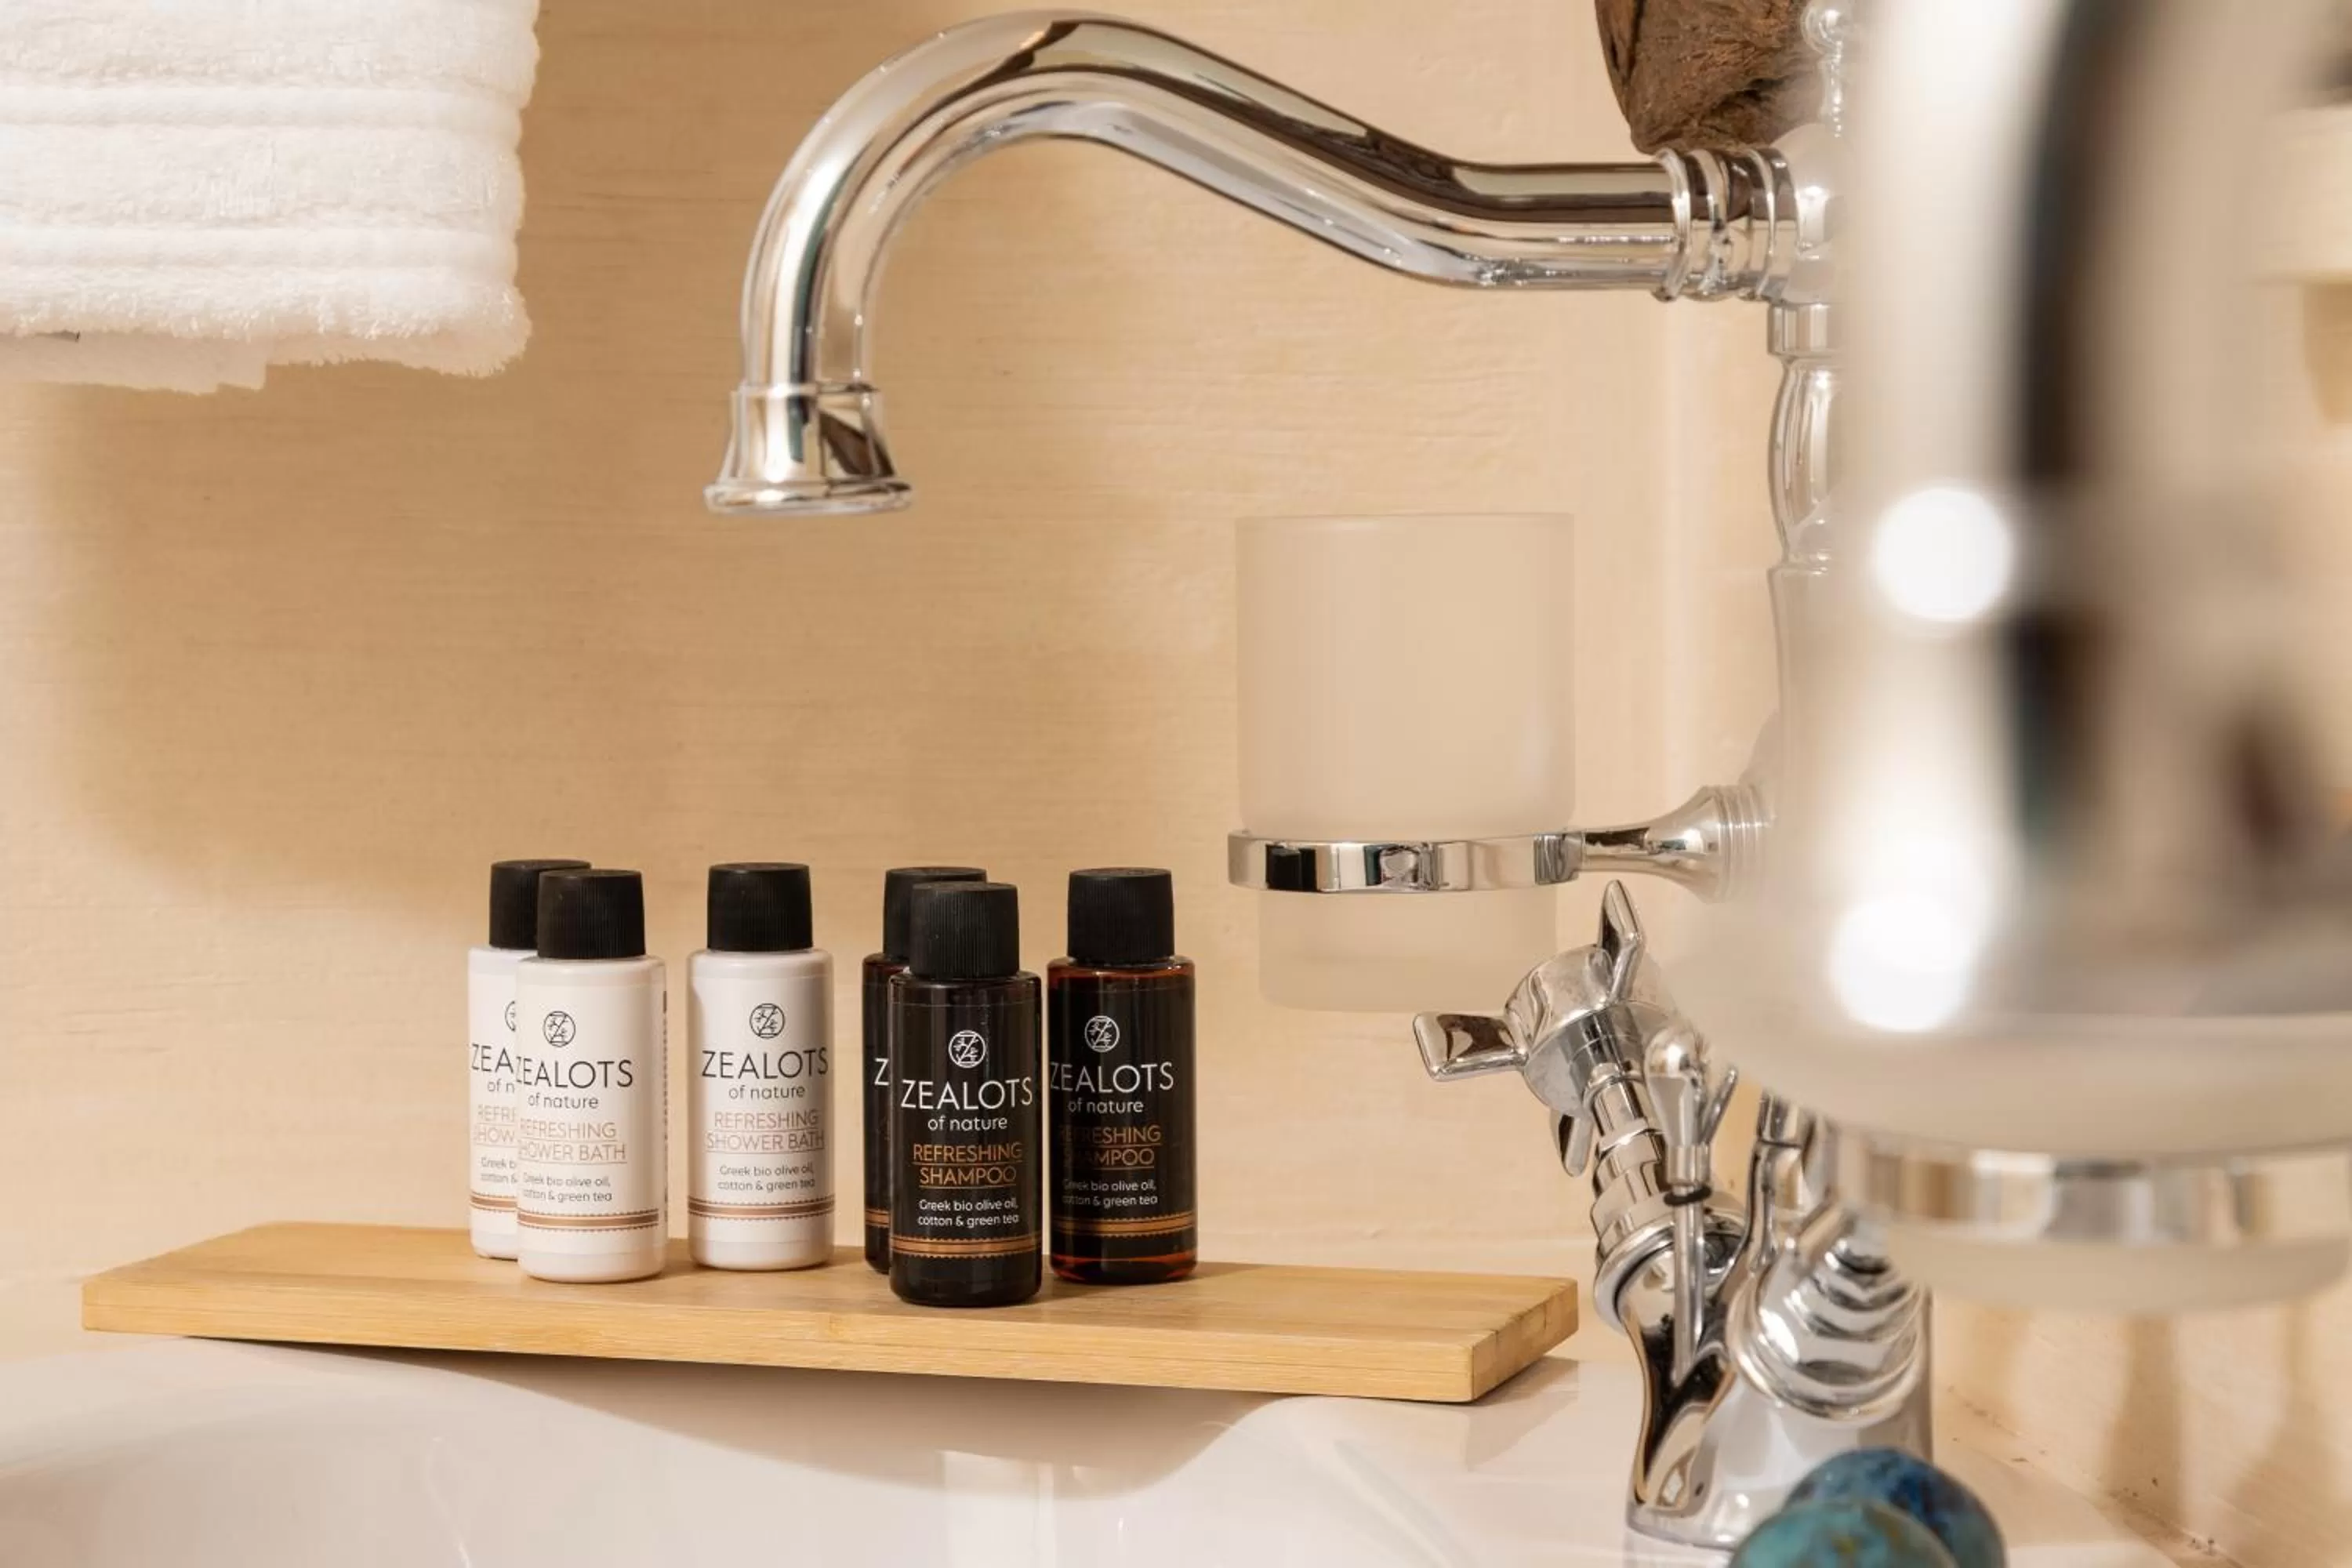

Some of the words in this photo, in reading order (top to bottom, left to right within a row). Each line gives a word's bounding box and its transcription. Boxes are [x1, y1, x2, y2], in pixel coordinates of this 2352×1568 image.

[702, 1047, 828, 1079] ZEALOTS
[515, 1056, 633, 1088] ZEALOTS
[1050, 1062, 1174, 1094] ZEALOTS
[487, 1079, 502, 1092] of
[728, 1085, 745, 1099] of
[750, 1086, 805, 1100] nature
[901, 1077, 1033, 1110] ZEALOTS
[528, 1092, 540, 1106] of
[543, 1094, 599, 1109] nature
[1068, 1098, 1083, 1112] of
[1087, 1100, 1144, 1114] nature
[714, 1109, 818, 1130] REFRESHING
[927, 1115, 946, 1131] of
[950, 1116, 1007, 1131] nature
[472, 1124, 515, 1143] HOW
[706, 1132, 784, 1151] SHOWER
[788, 1131, 825, 1149] BATH
[1060, 1124, 1162, 1145] EFRESHING
[518, 1140, 573, 1161] HOWER
[579, 1143, 626, 1161] BATH
[913, 1142, 1023, 1162] REFRESHING
[1063, 1148, 1155, 1167] MPOO
[720, 1164, 750, 1175] Greek
[754, 1166, 771, 1176] bio
[775, 1165, 799, 1176] olive
[919, 1166, 1017, 1185] SHAMPOO
[546, 1176, 563, 1186] bio
[565, 1176, 591, 1187] olive
[718, 1181, 753, 1191] cotton
[756, 1181, 763, 1190] &
[766, 1181, 798, 1192] green
[800, 1178, 815, 1189] tea
[1091, 1180, 1109, 1192] bio
[1111, 1179, 1138, 1192] olive
[549, 1191, 555, 1200] &
[557, 1192, 590, 1203] green
[592, 1191, 612, 1201] tea
[919, 1199, 951, 1211] Greek
[954, 1200, 973, 1211] bio
[976, 1199, 1001, 1211] olive
[1093, 1196, 1101, 1206] &
[1103, 1196, 1137, 1209] green
[1139, 1194, 1158, 1205] tea
[917, 1216, 952, 1227] cotton
[956, 1216, 964, 1227] &
[967, 1216, 1000, 1229] green
[1003, 1214, 1019, 1224] tea
